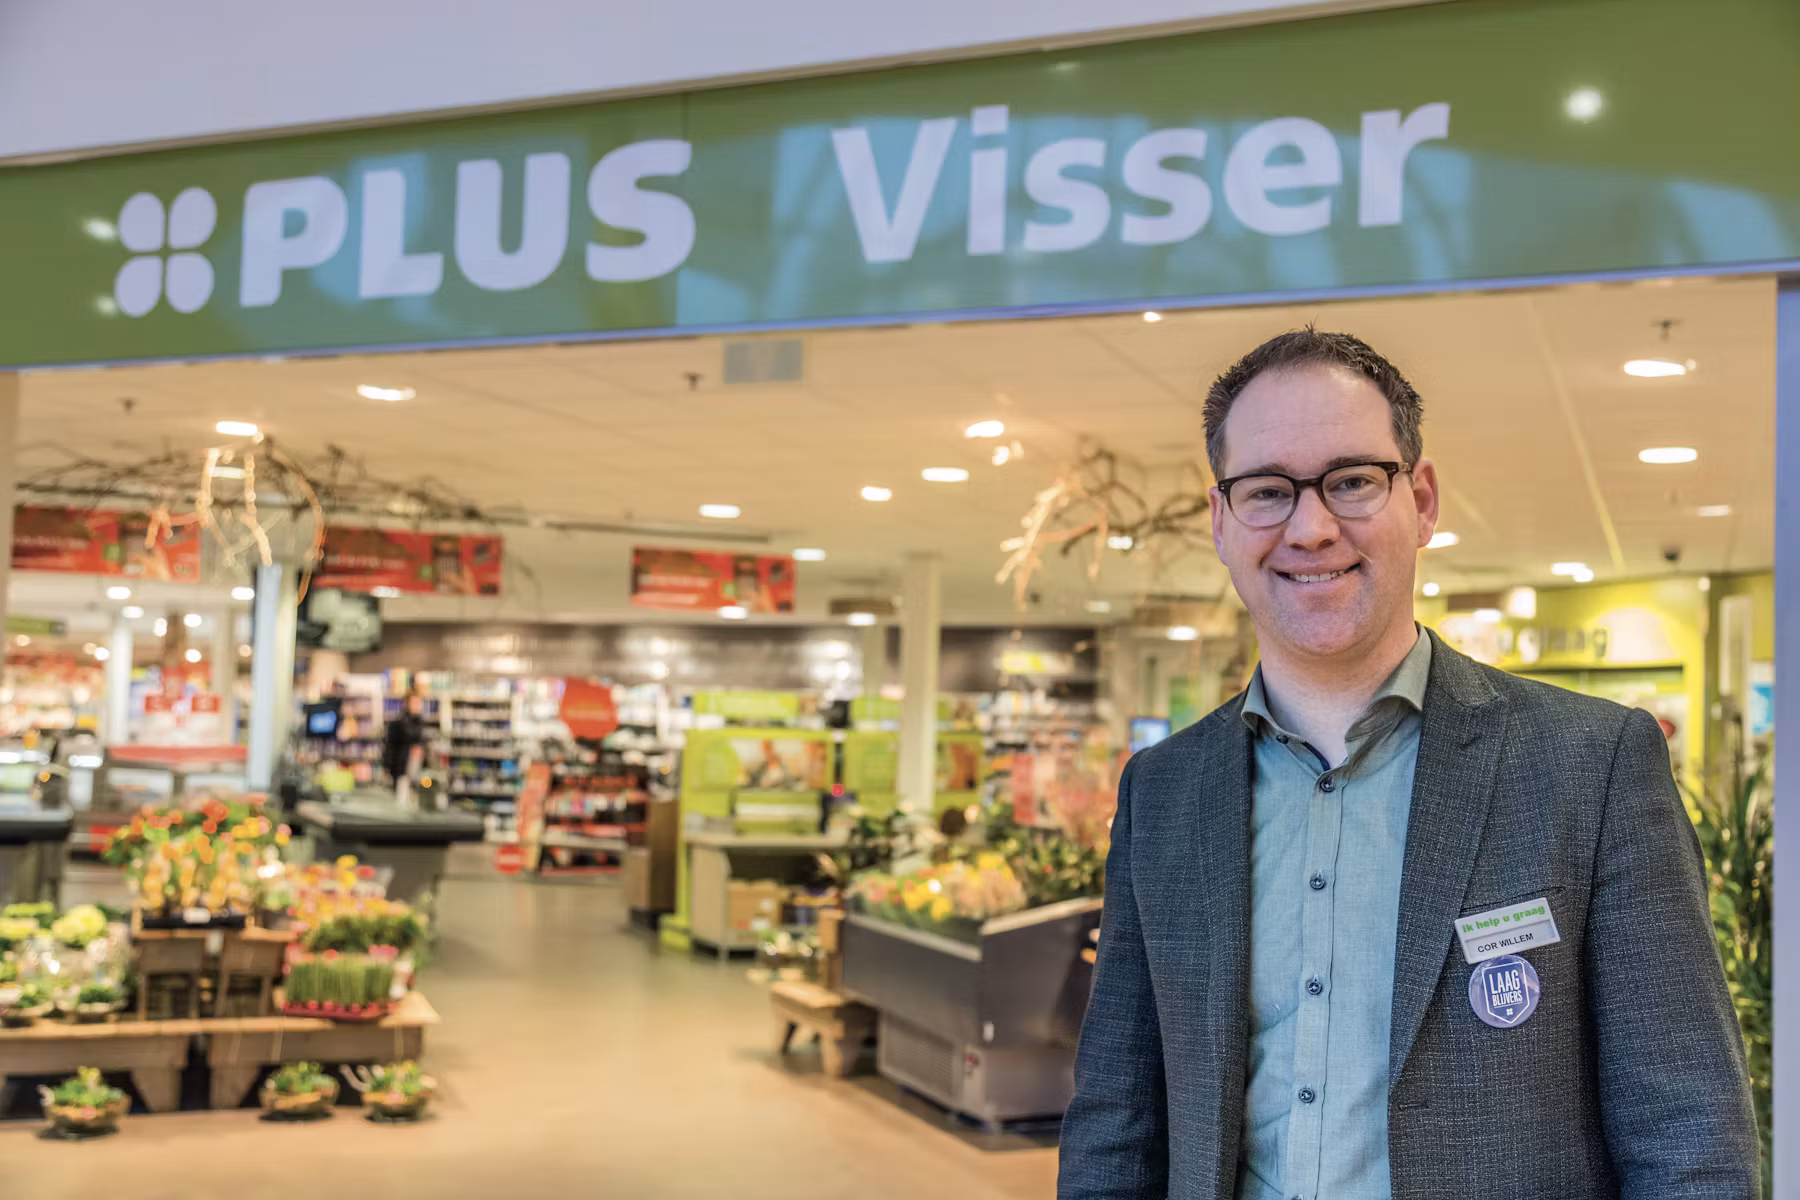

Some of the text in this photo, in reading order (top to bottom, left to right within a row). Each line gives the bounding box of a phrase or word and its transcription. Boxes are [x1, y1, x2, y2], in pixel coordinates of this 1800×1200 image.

[239, 102, 1452, 308] PLUS Visser
[1475, 917, 1500, 930] help
[1502, 915, 1510, 923] u
[1513, 906, 1545, 921] graag
[1477, 933, 1534, 953] COR WILLEM
[1489, 969, 1520, 994] LAAG
[1492, 990, 1522, 1006] BLIJVERS
